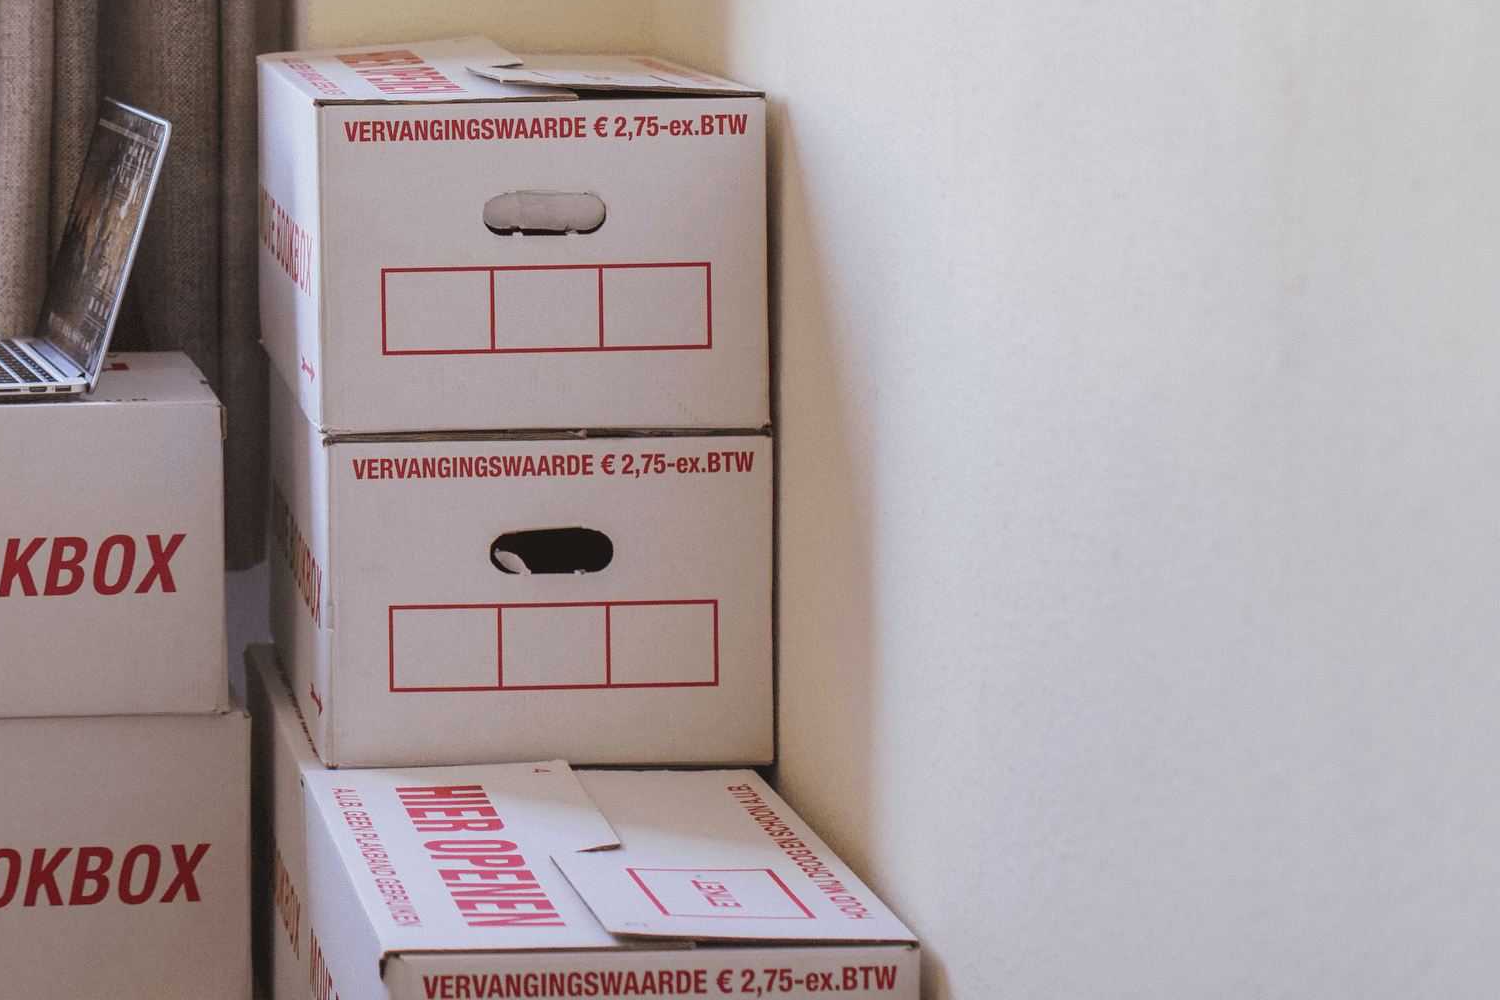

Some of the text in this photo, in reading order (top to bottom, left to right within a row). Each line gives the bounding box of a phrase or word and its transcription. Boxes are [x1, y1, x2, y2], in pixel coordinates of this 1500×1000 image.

[344, 113, 748, 143] VERVANGINGSWAARDE € 2,75-ex.BTW
[276, 205, 312, 297] BOOKBOX
[352, 450, 755, 480] VERVANGINGSWAARDE € 2,75-ex.BTW
[727, 783, 766, 805] A.U.B.
[343, 810, 376, 831] GEEN
[744, 805, 795, 837] SCHOON
[353, 832, 396, 876] PLAKBAND
[395, 785, 567, 927] HIER OPENEN
[773, 837, 806, 849] EN
[785, 849, 835, 879] DROOG
[690, 879, 742, 908] ETIKET
[829, 895, 875, 919] HOUD
[423, 965, 897, 999] VERVANGINGSWAARDE € 2,75-ex.BTW
